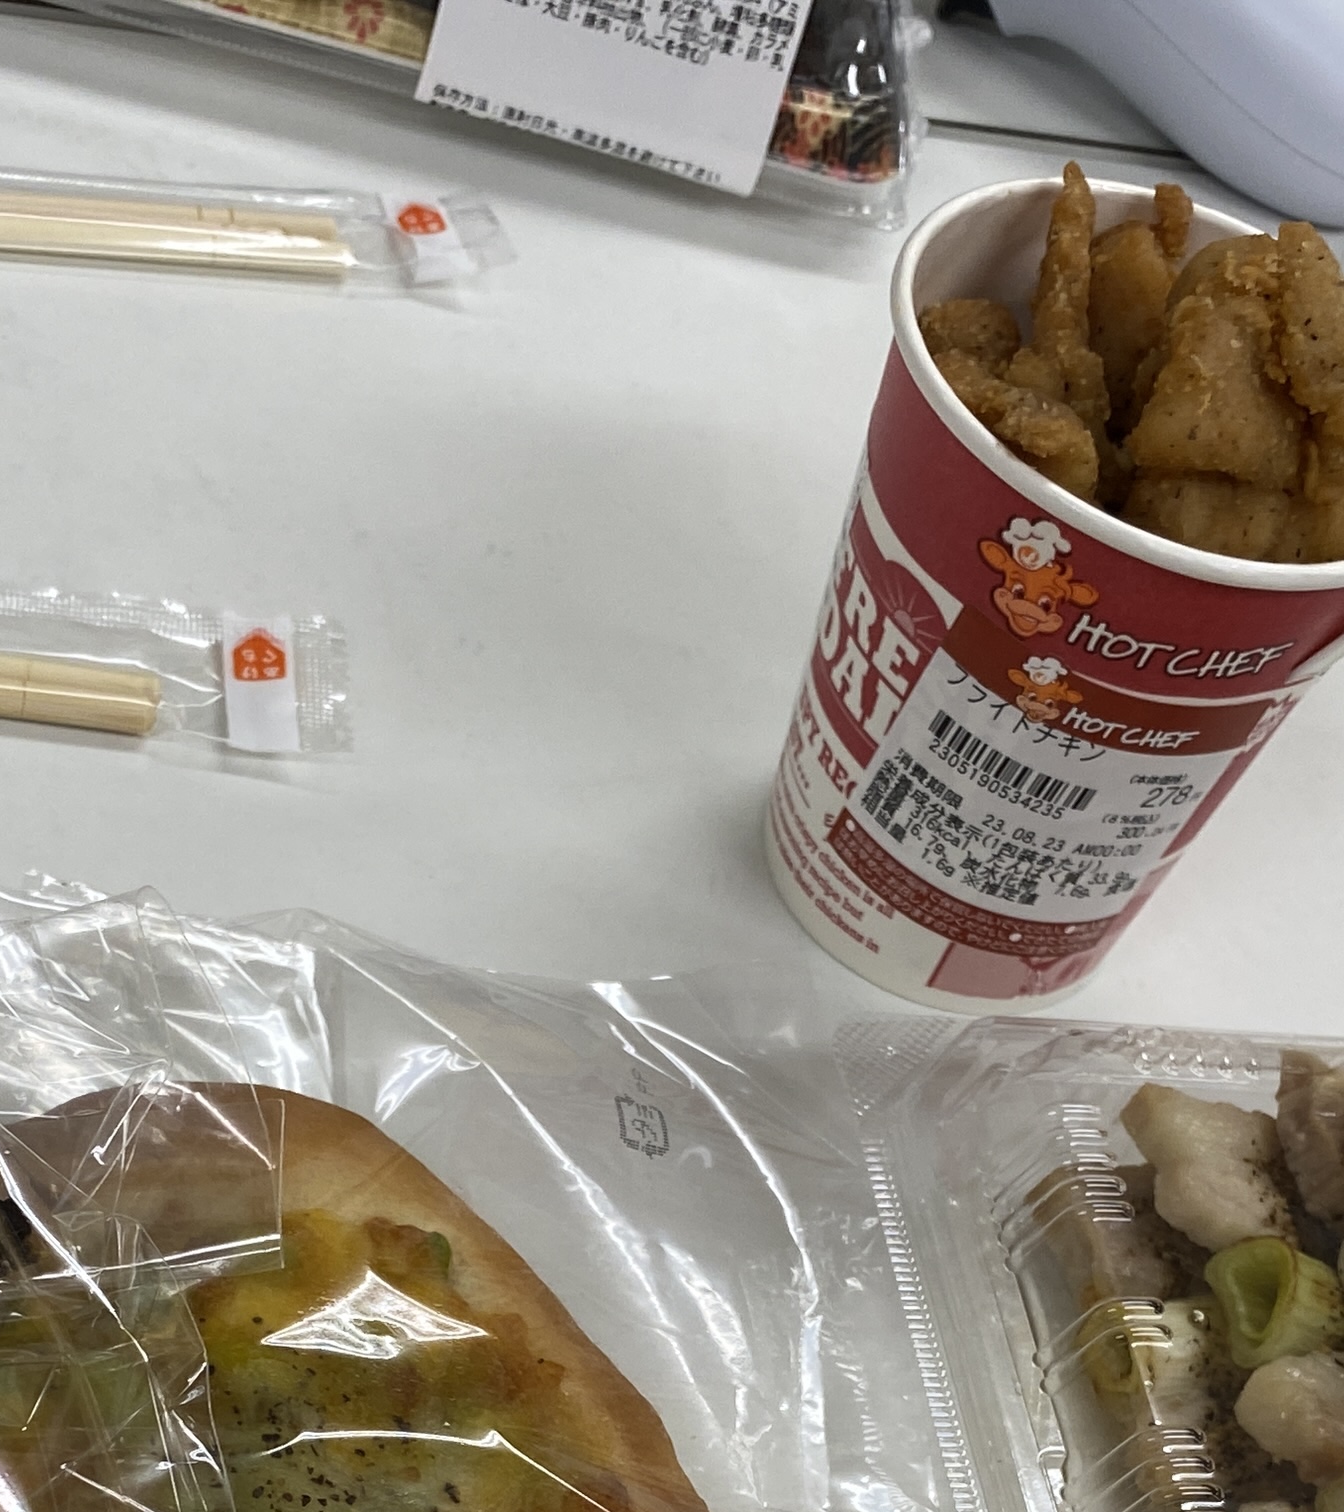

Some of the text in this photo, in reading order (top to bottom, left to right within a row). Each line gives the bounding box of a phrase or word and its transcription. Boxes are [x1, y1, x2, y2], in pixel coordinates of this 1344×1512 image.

[1067, 613, 1295, 678] HOT CHEF
[1062, 706, 1200, 749] HOT CHEF
[1139, 785, 1194, 809] 278
